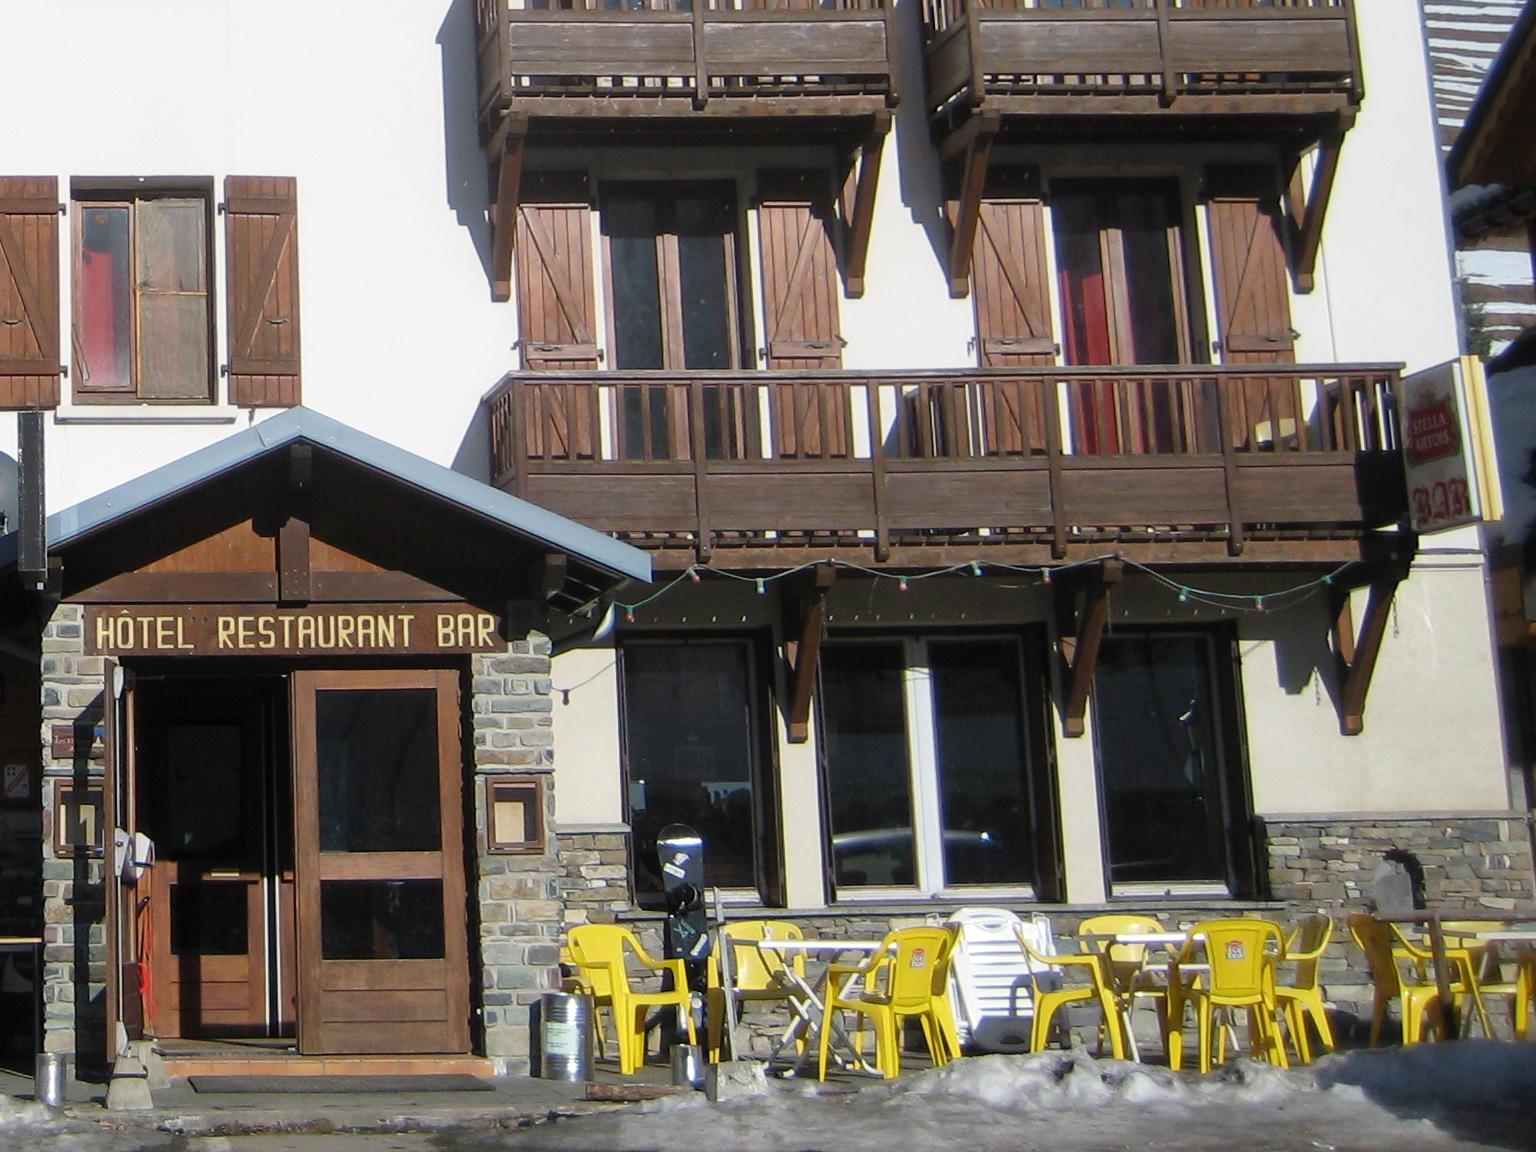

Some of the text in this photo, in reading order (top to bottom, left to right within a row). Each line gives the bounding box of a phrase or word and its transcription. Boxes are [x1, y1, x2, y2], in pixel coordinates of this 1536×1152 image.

[1413, 412, 1447, 435] STELLA
[1415, 429, 1450, 450] ARTOIS
[1413, 478, 1469, 528] BAR
[217, 614, 415, 649] RESTAURANT
[437, 613, 496, 648] BAR
